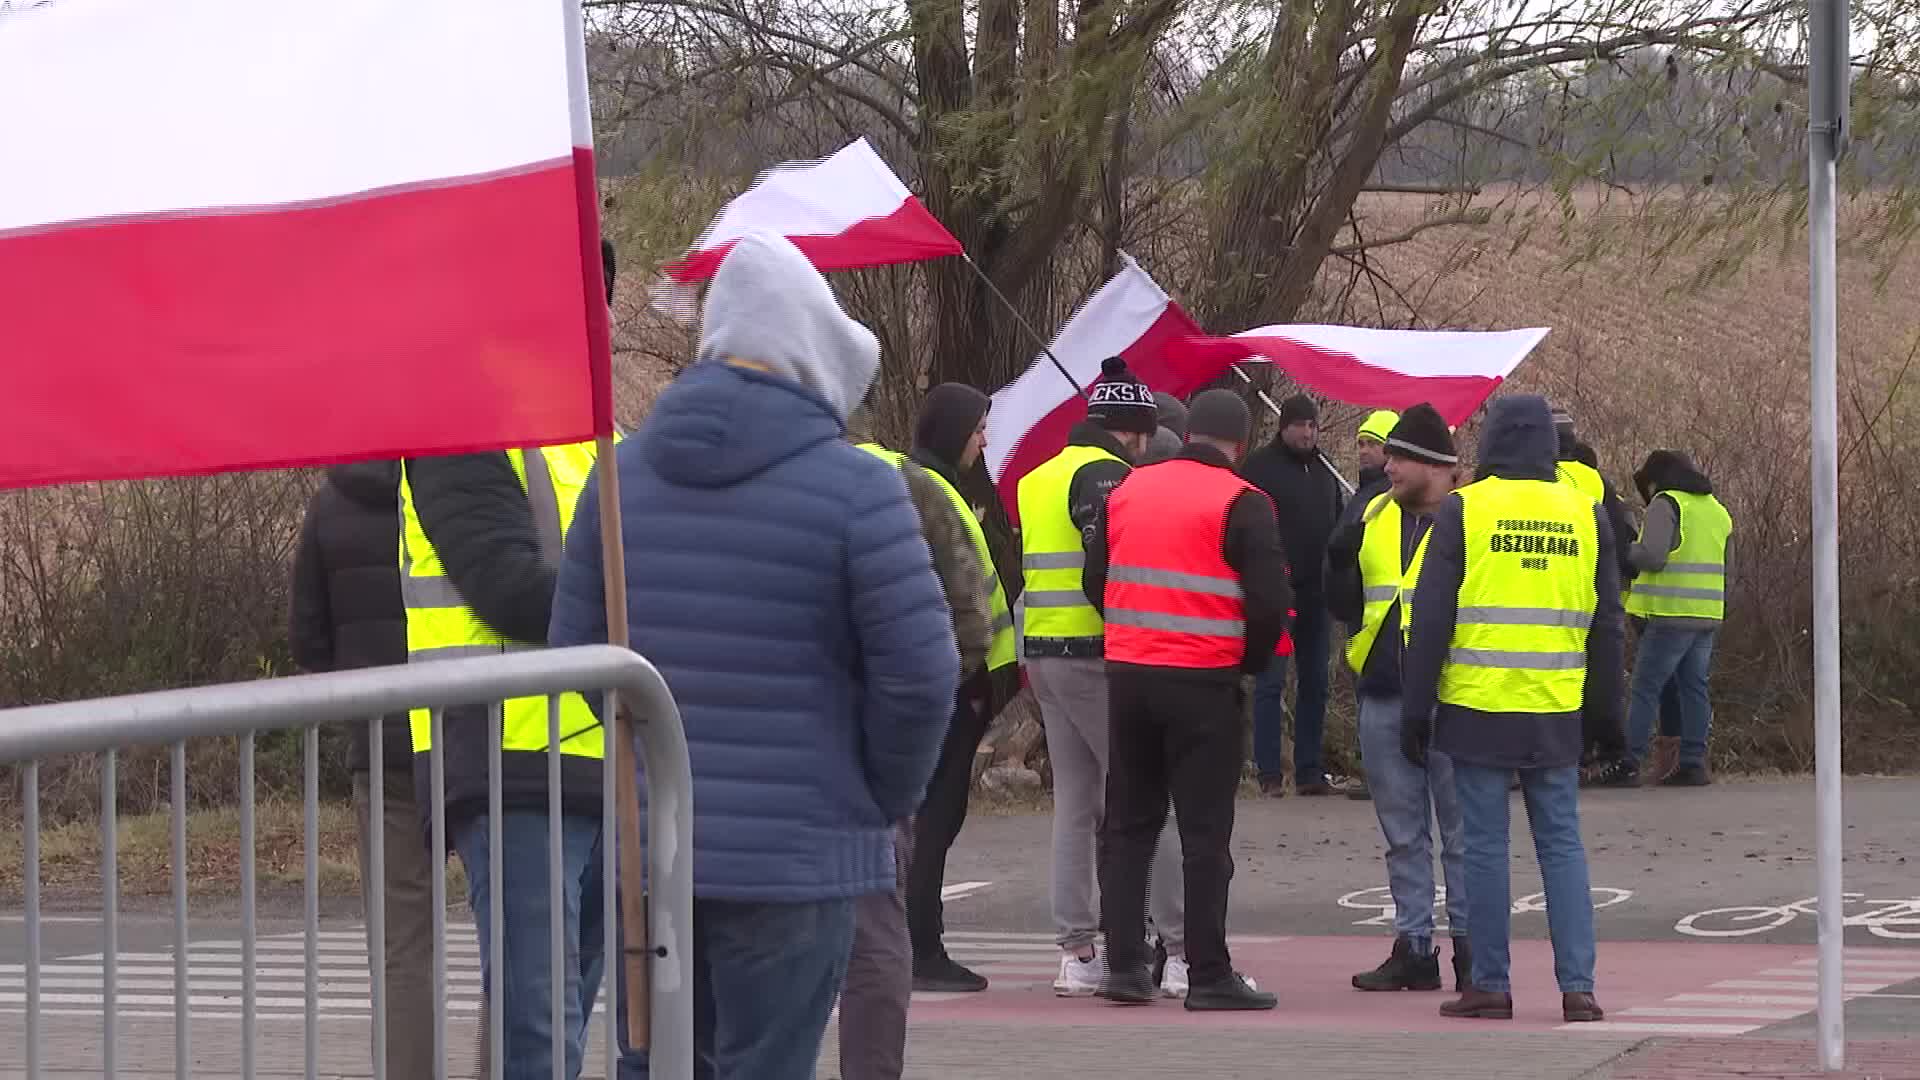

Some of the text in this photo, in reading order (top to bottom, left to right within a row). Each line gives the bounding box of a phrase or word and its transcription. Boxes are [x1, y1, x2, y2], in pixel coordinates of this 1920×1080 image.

[1497, 519, 1574, 535] PODKARPACKA
[1490, 533, 1580, 557] OSZUKANA
[1521, 556, 1549, 571] WIEŚ
